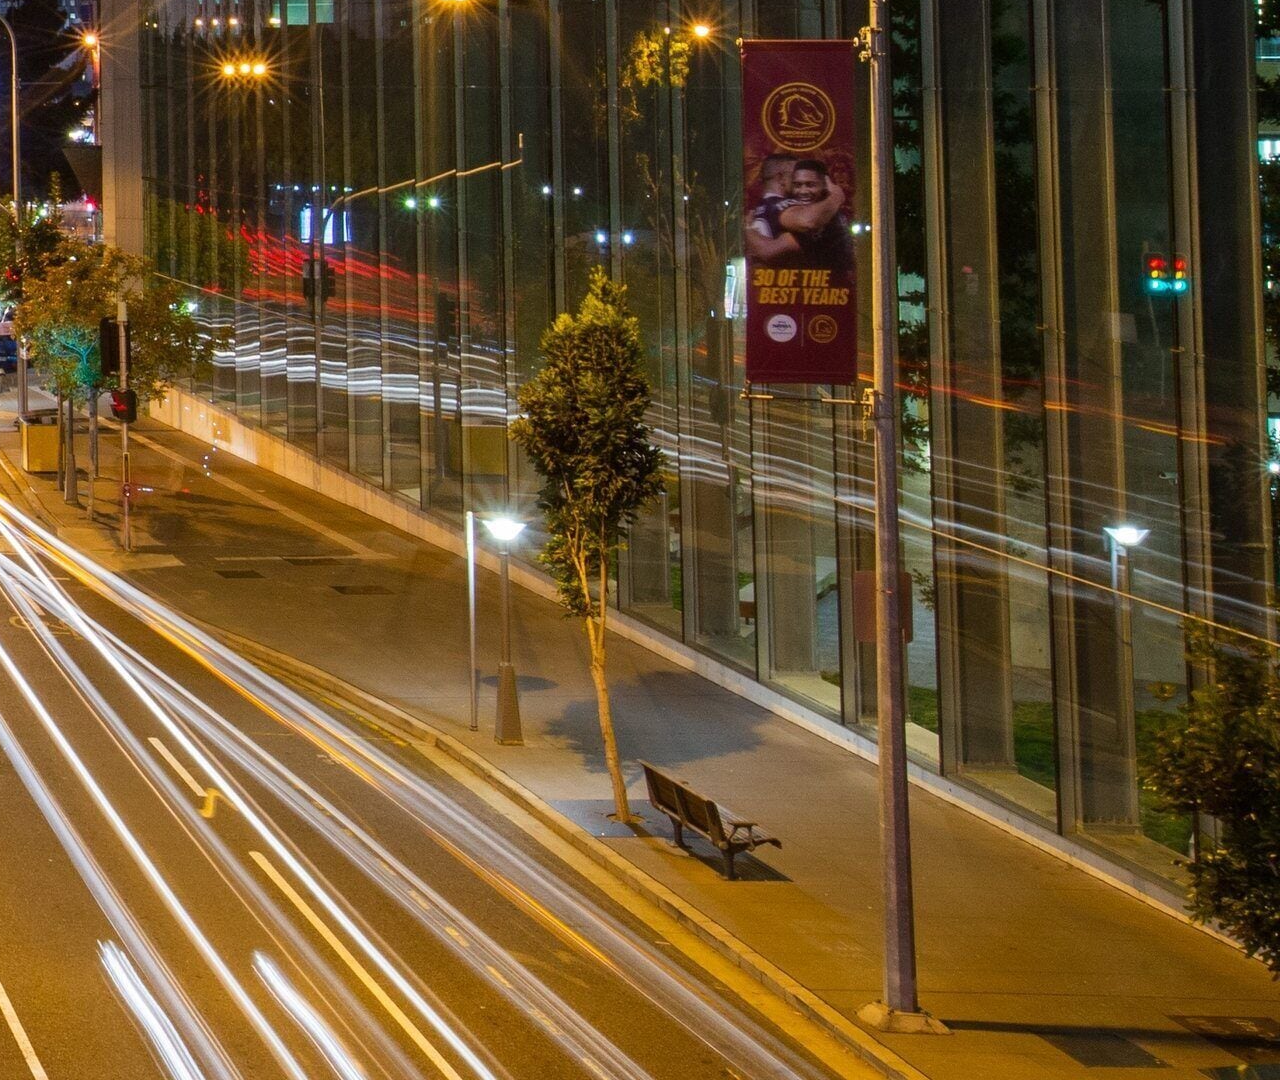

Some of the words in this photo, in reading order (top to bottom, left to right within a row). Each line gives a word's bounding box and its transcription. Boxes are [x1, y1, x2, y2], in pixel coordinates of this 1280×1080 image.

[753, 268, 775, 286] 30
[778, 268, 799, 287] OF
[801, 269, 832, 287] THE
[759, 287, 800, 304] BEST
[802, 288, 850, 306] YEARS
